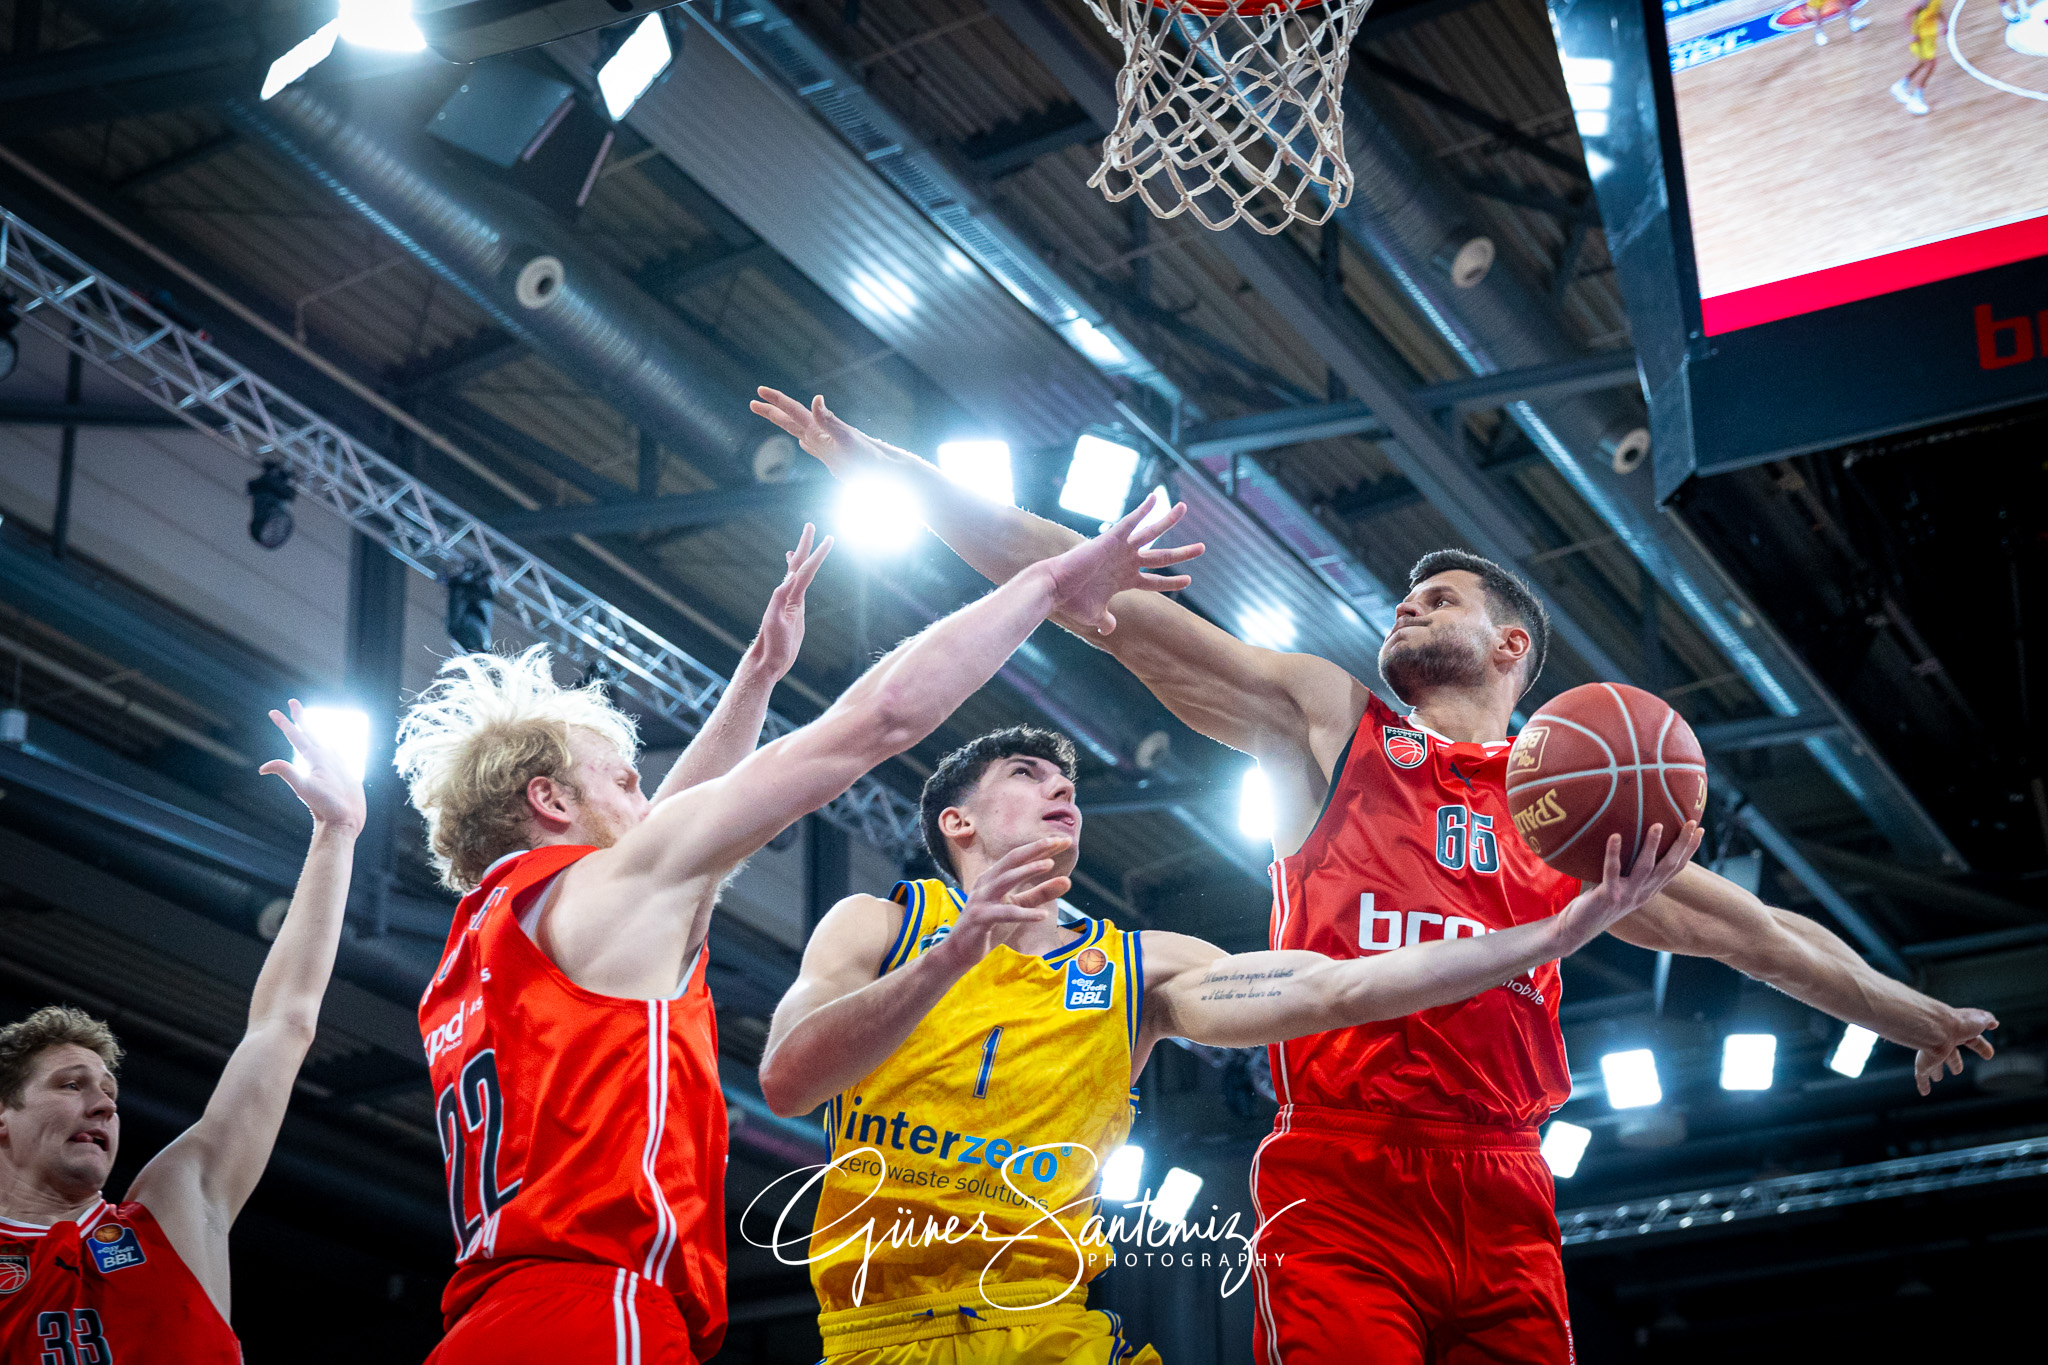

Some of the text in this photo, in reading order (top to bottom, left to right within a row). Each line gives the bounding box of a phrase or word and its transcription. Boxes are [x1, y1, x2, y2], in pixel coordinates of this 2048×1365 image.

[1436, 804, 1499, 873] 65
[1070, 992, 1105, 1005] BBL
[973, 1025, 1004, 1100] 1
[437, 1047, 524, 1263] 22
[838, 1155, 1049, 1211] zero waste solutions
[103, 1252, 139, 1269] BBL
[37, 1308, 113, 1365] 33
